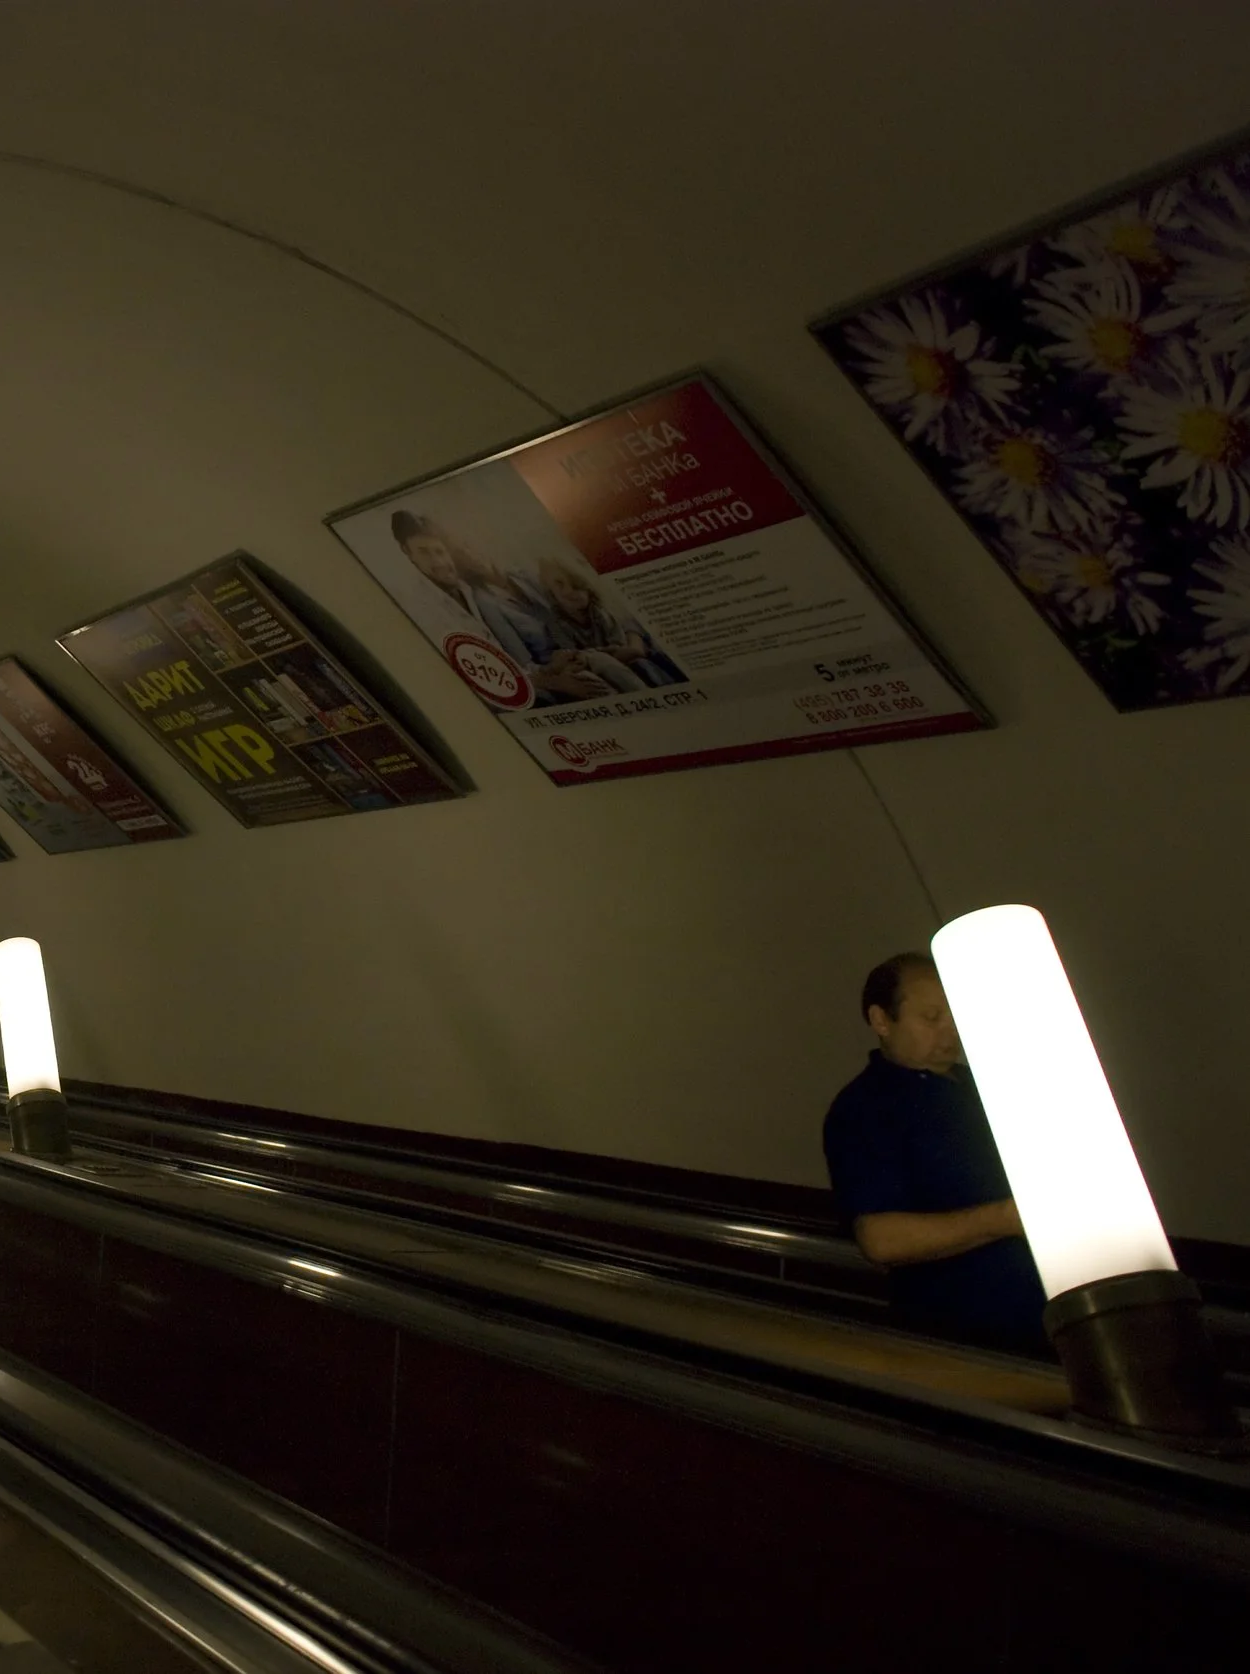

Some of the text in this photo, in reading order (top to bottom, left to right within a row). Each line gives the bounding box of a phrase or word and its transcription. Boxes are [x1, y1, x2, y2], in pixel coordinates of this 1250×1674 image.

[616, 499, 754, 556] БЕСПЛАТНО
[122, 659, 208, 713] ДАРИТ
[814, 663, 836, 682] 5
[696, 688, 709, 701] 1
[792, 680, 910, 712] (495) 787 38 38
[847, 702, 880, 719] 200
[174, 722, 278, 785] ИГР
